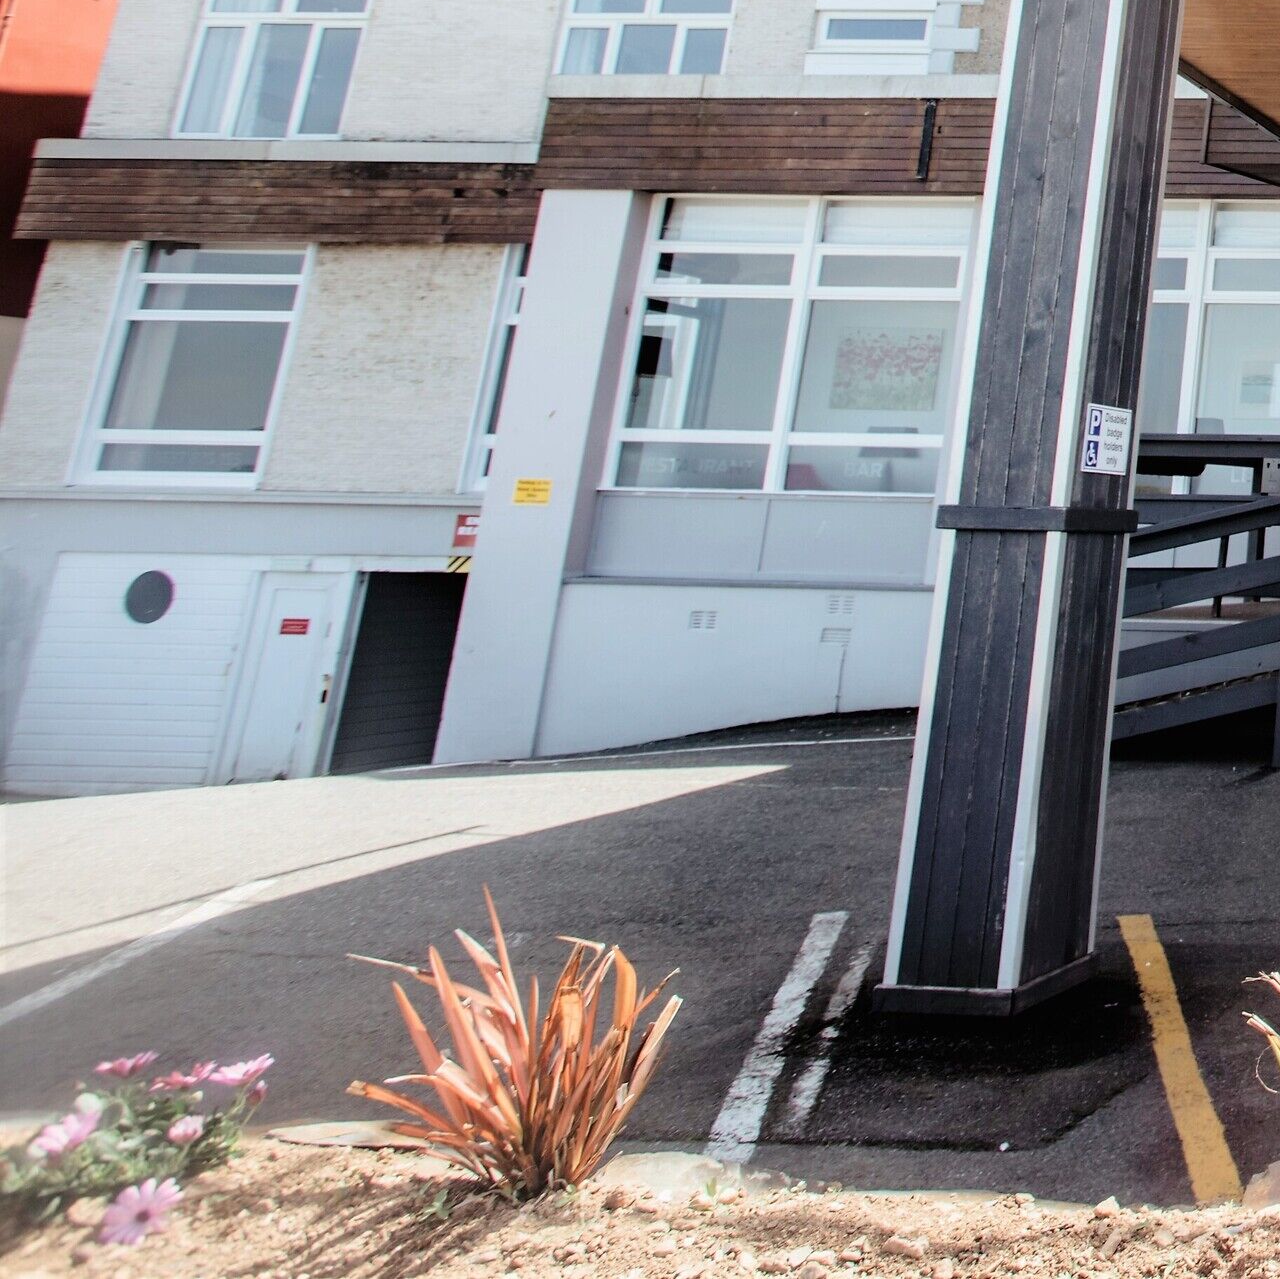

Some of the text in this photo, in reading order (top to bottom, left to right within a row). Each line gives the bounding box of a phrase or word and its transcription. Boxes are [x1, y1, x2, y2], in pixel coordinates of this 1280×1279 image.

[1105, 412, 1128, 425] Disabled
[1106, 428, 1123, 440] badge
[1104, 441, 1123, 453] holders
[1106, 456, 1118, 468] only
[844, 462, 883, 478] BAR
